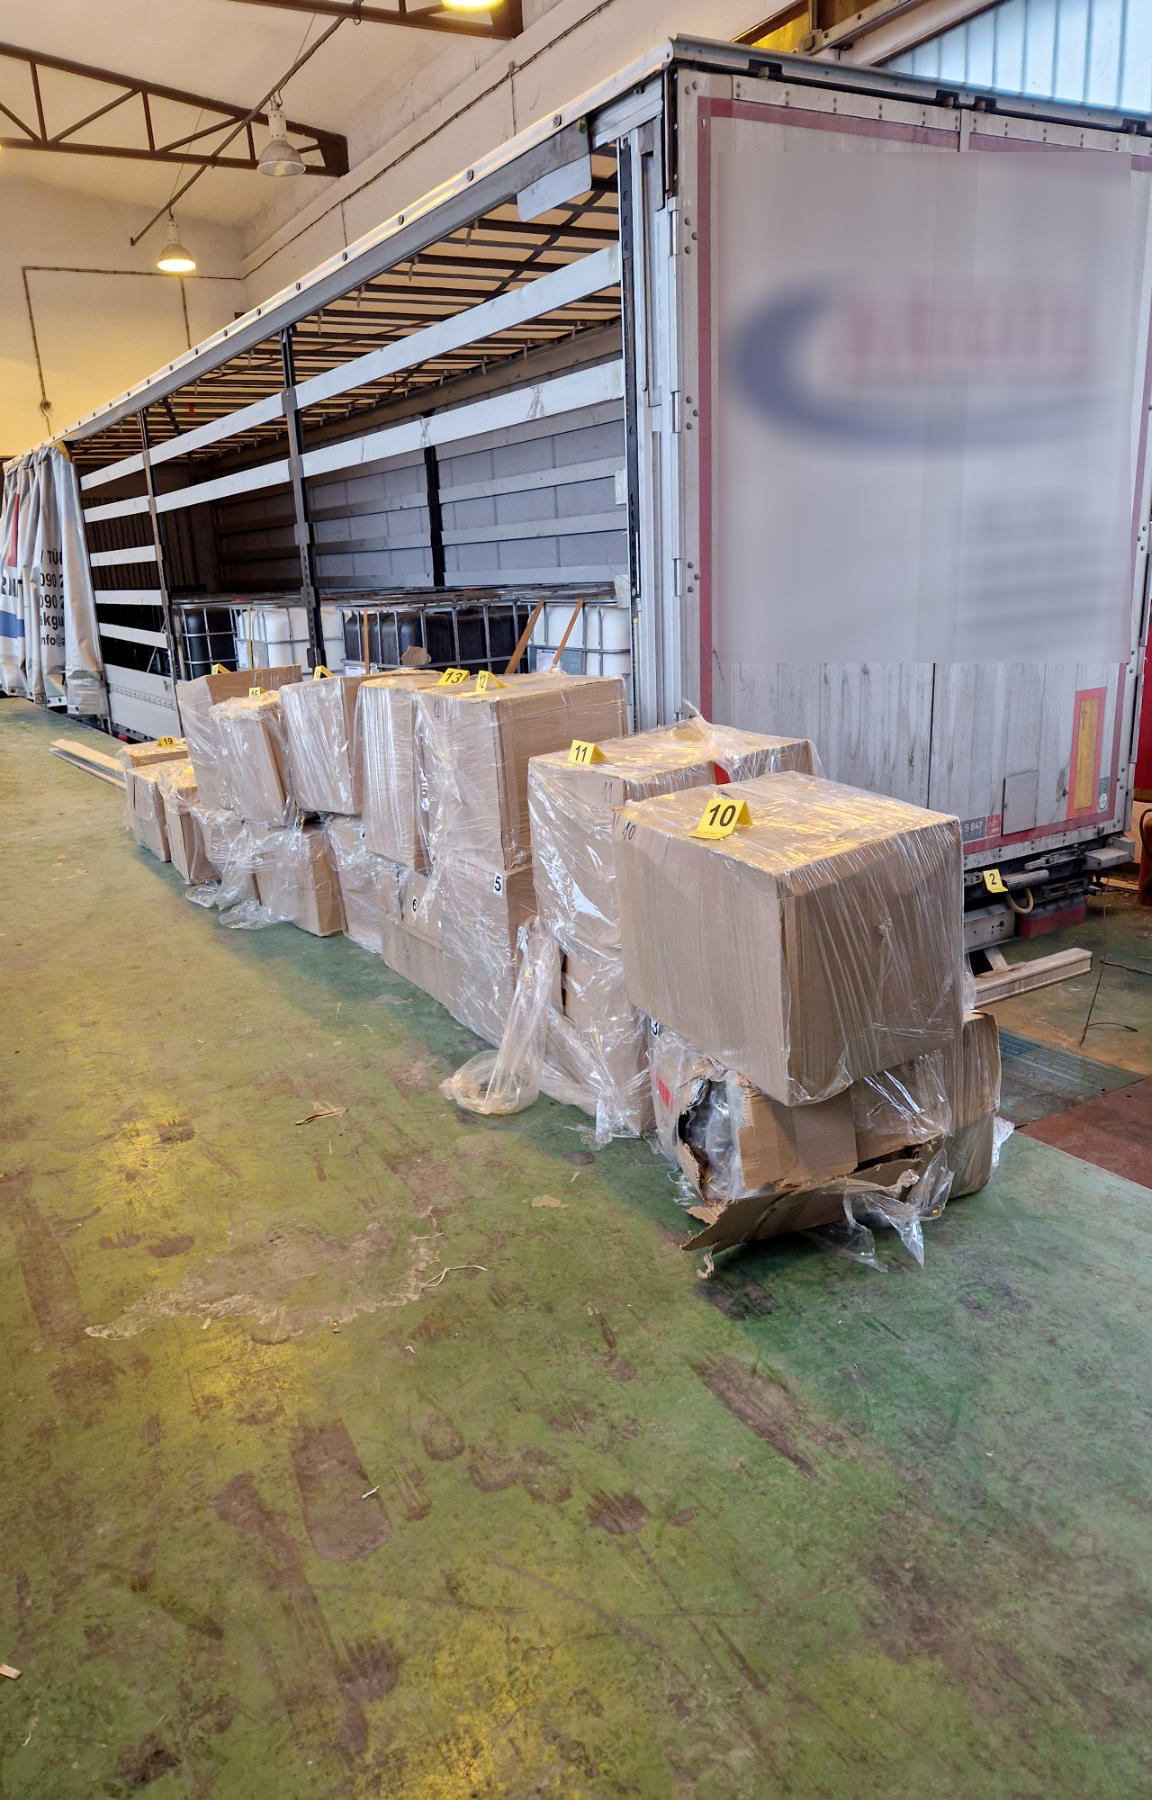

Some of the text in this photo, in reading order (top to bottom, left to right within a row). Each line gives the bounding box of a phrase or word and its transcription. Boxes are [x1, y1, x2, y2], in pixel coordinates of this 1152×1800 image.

[444, 671, 463, 684] 13
[163, 737, 173, 745] 19
[574, 744, 588, 763] 11
[708, 804, 737, 828] 10
[621, 820, 636, 841] 10
[494, 876, 502, 892] 5
[989, 872, 997, 885] 2
[412, 898, 418, 912] 6
